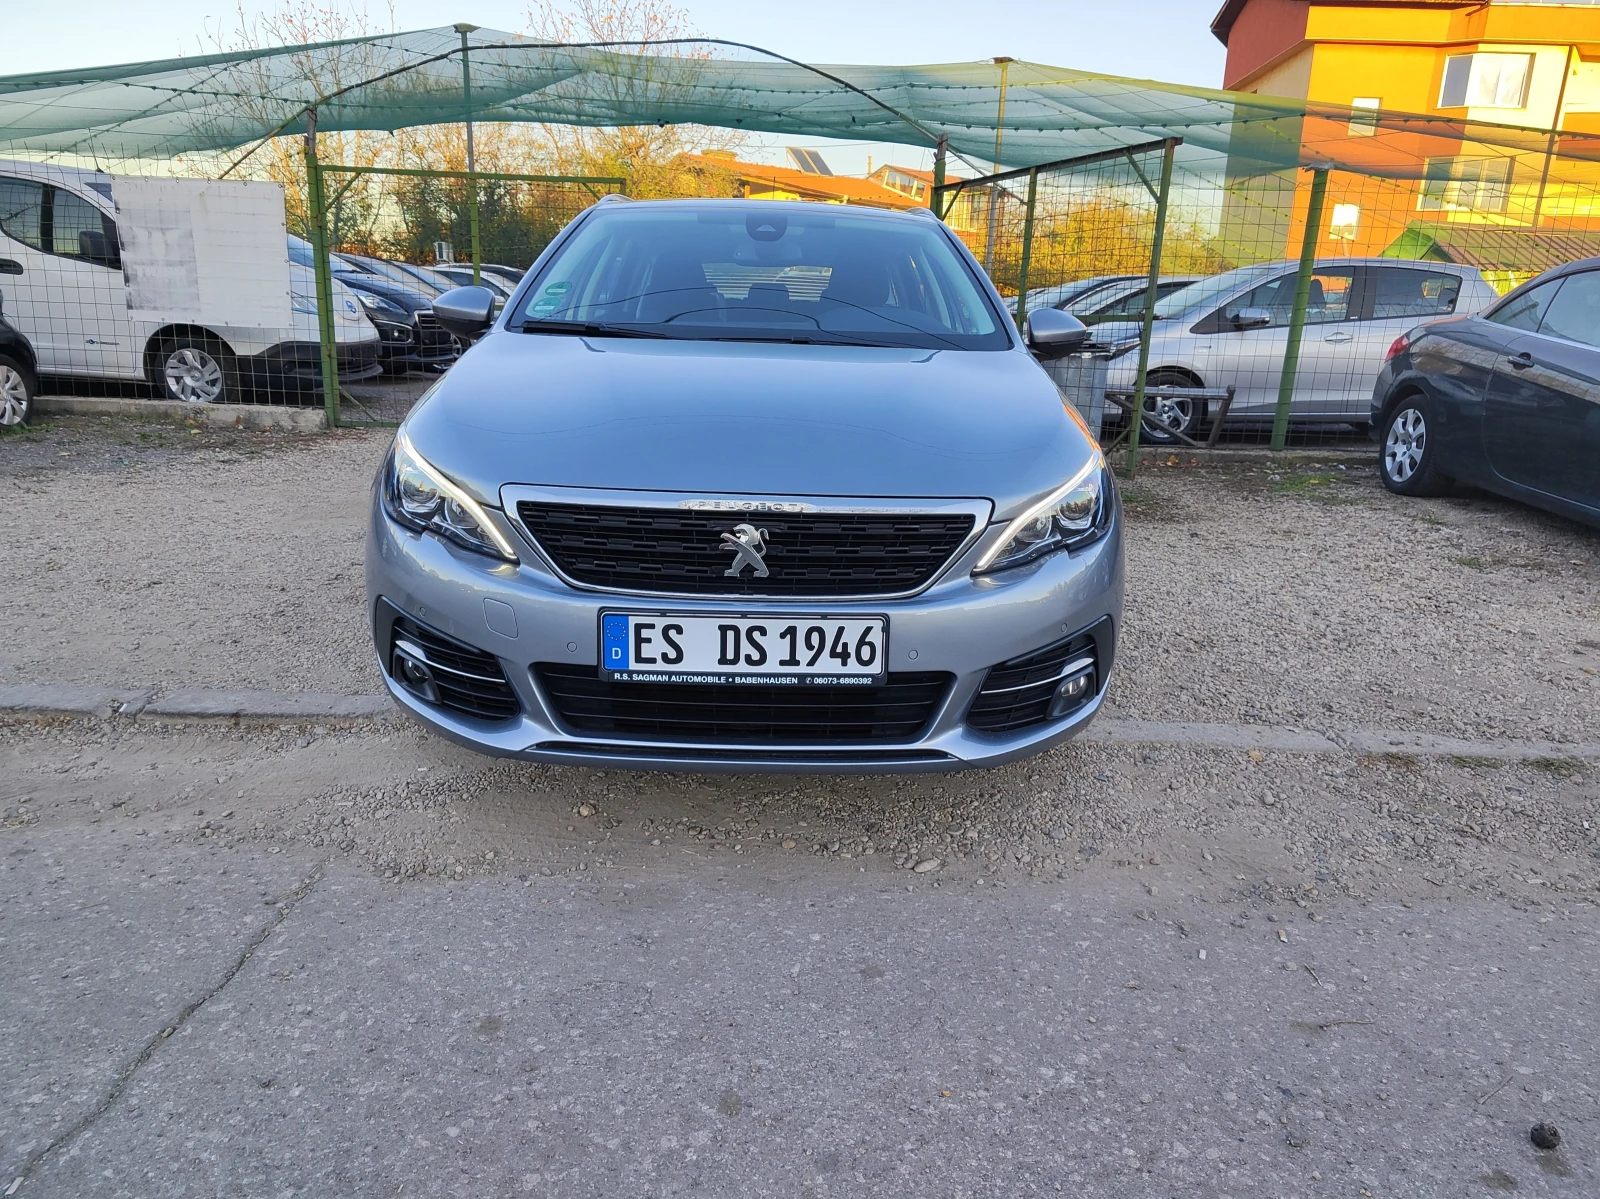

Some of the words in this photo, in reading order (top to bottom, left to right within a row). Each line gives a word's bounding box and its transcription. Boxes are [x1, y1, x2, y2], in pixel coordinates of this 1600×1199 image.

[698, 501, 798, 511] PEUGEOT
[634, 623, 684, 665] ES
[717, 624, 768, 667] DS
[778, 625, 877, 667] 1946
[612, 647, 622, 659] D
[614, 673, 631, 681] R.S.
[632, 674, 669, 682] SAGMAN
[670, 675, 727, 683] AUTOMOBILE
[734, 676, 798, 684] BABENHAUSEN
[813, 677, 873, 685] 06073-6890392
